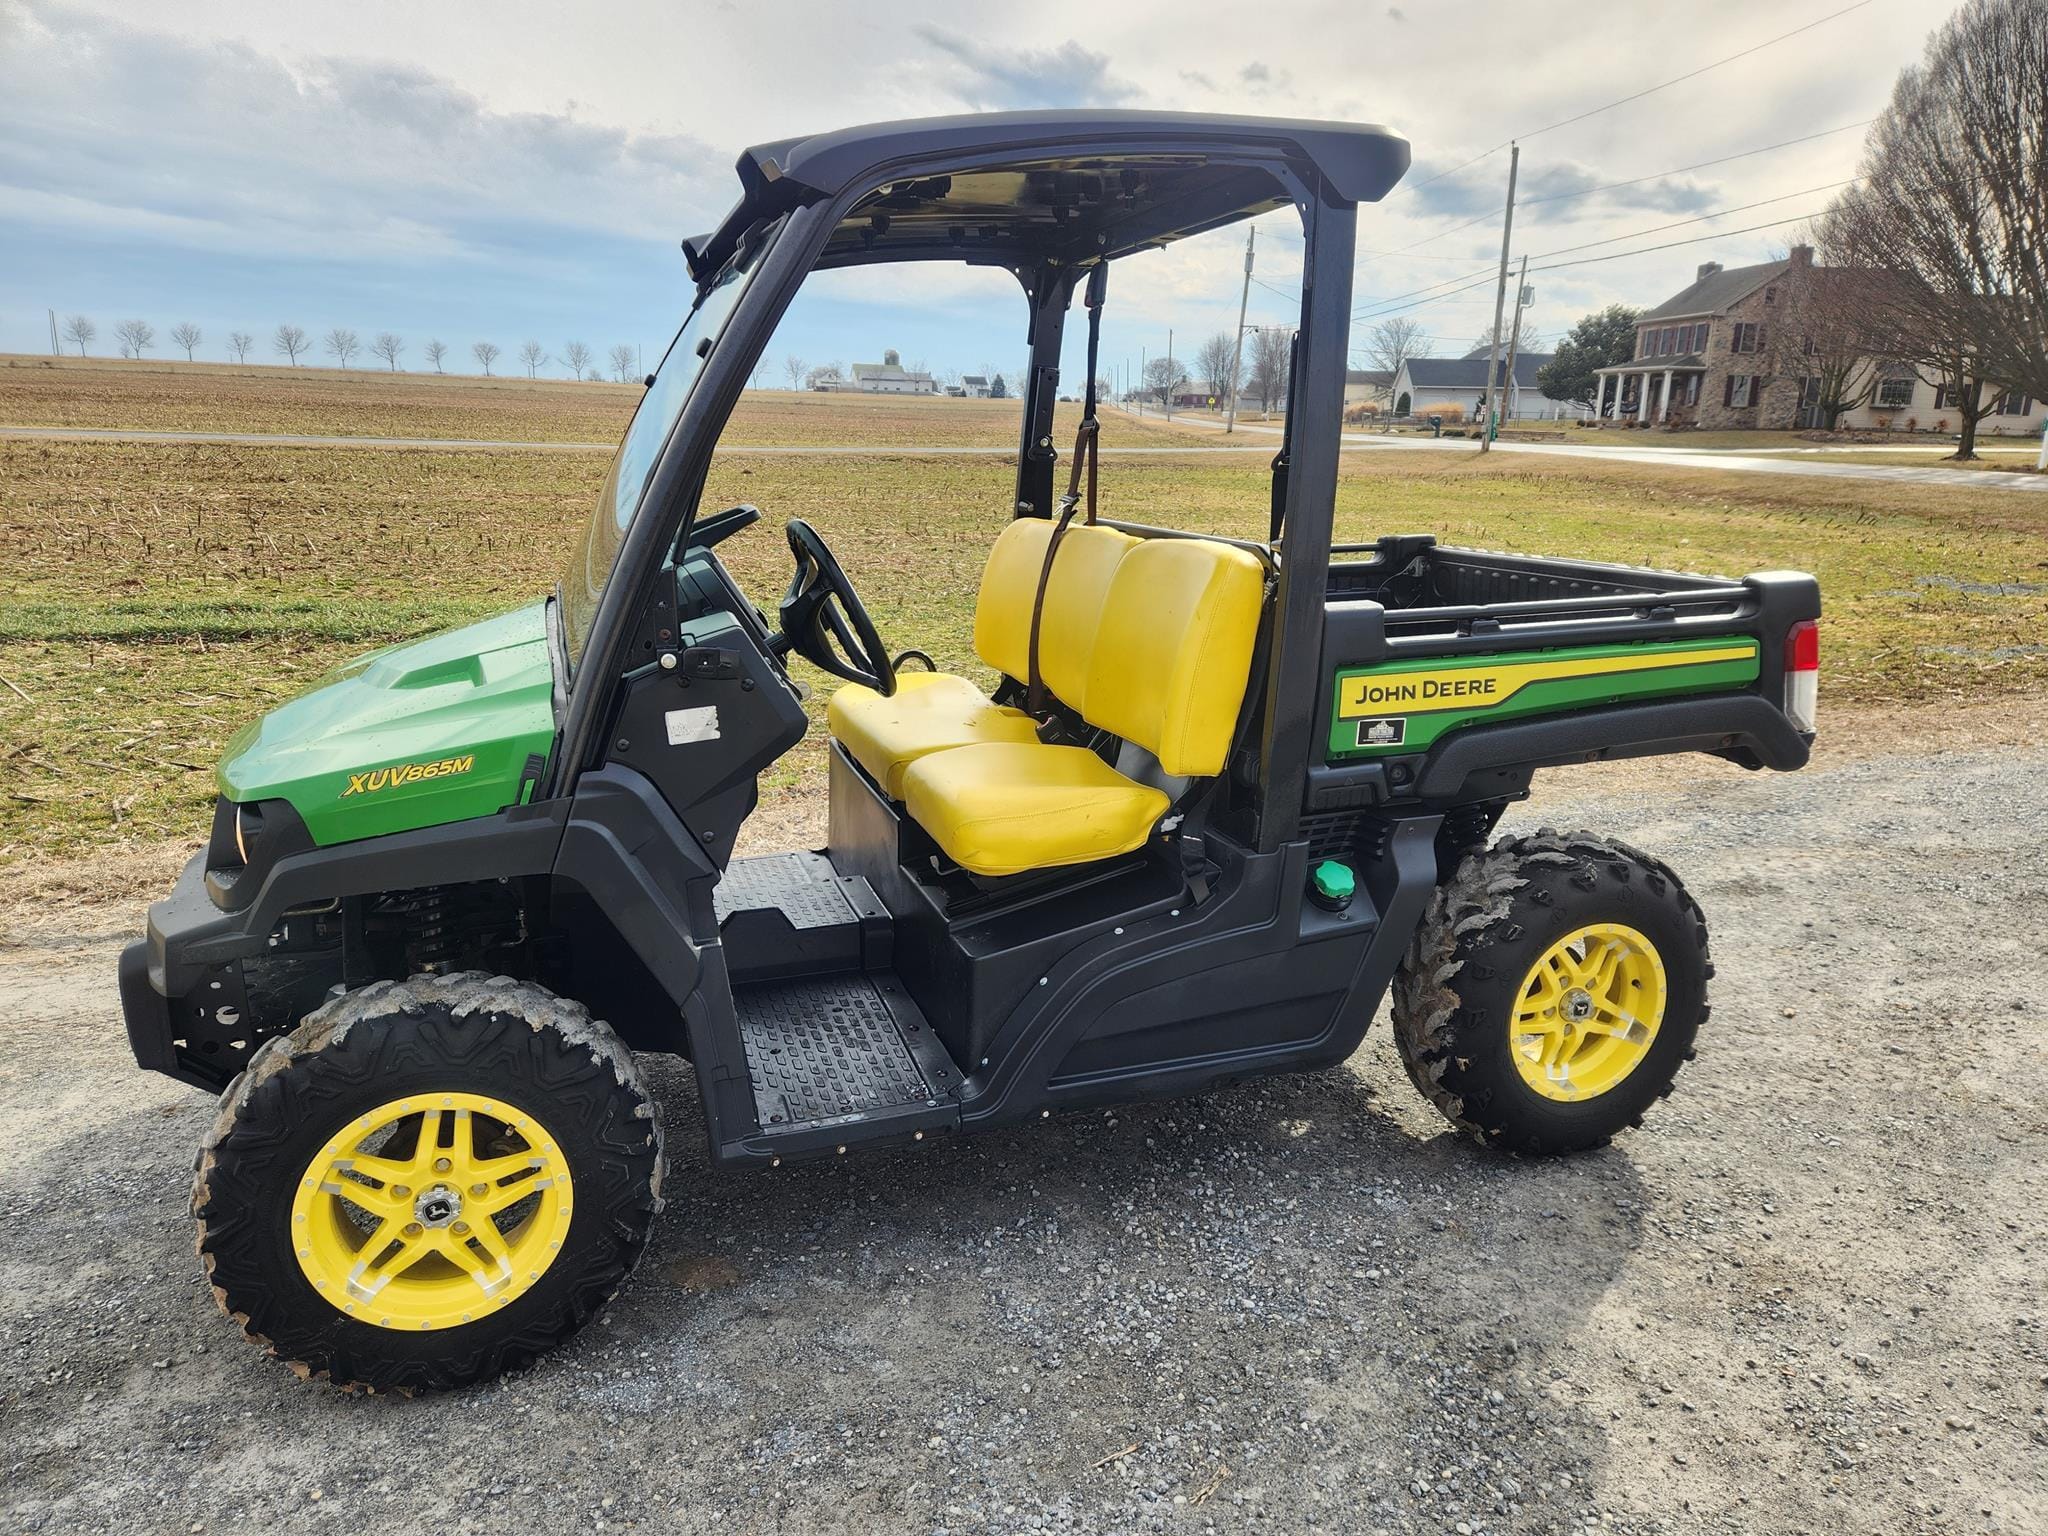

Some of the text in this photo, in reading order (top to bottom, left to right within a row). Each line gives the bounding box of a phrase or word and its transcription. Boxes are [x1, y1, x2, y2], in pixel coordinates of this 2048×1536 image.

[1355, 678, 1497, 704] JOHN DEERE
[341, 755, 474, 797] XUV865M
